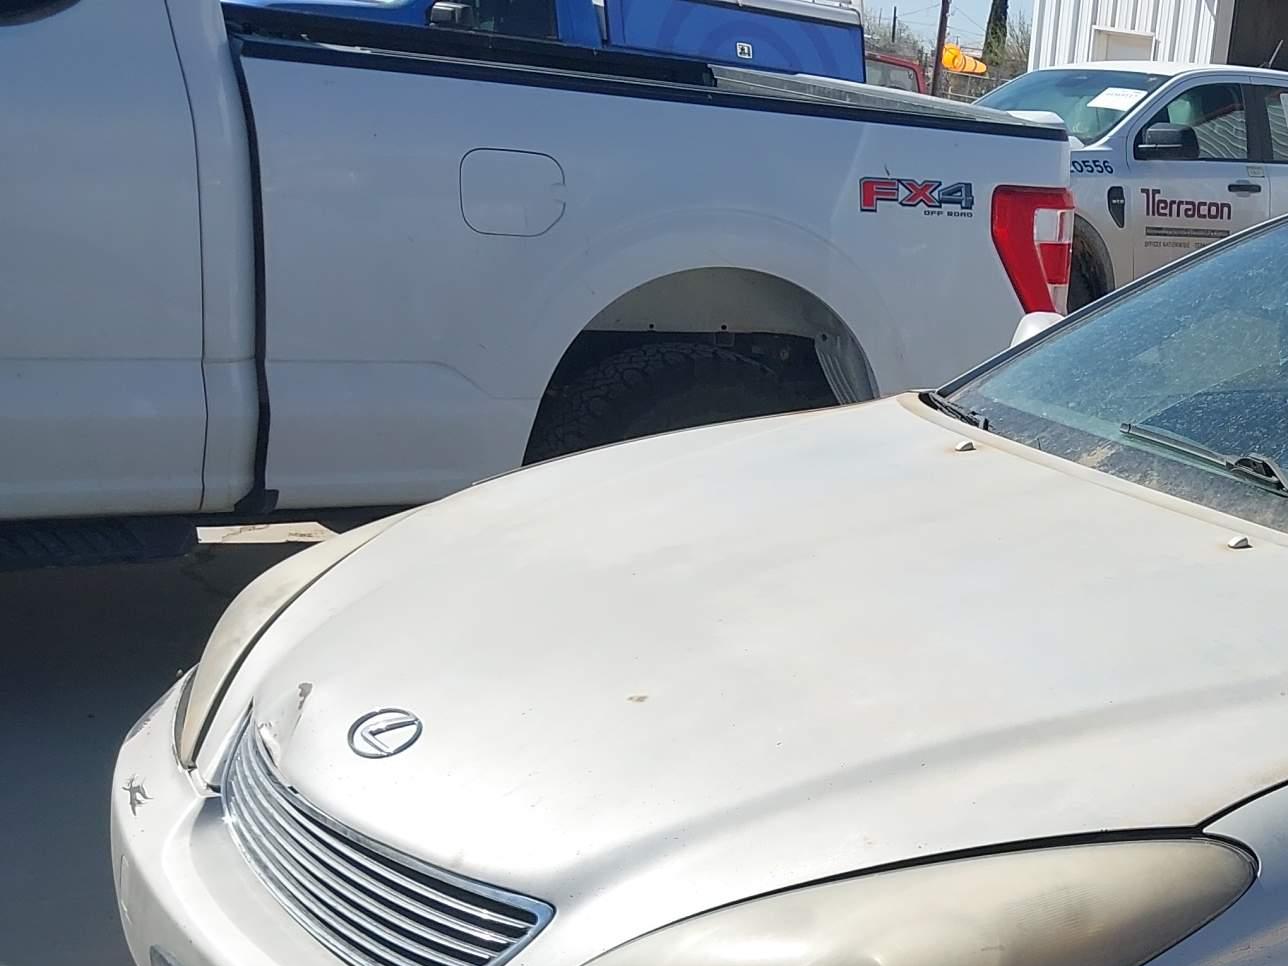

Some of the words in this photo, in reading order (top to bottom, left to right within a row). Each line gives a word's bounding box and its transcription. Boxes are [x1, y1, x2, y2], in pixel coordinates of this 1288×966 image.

[1070, 160, 1114, 175] 0556
[859, 176, 975, 212] FX4
[1140, 188, 1232, 220] Terracon
[923, 209, 944, 217] OFF
[946, 210, 973, 218] ROAD
